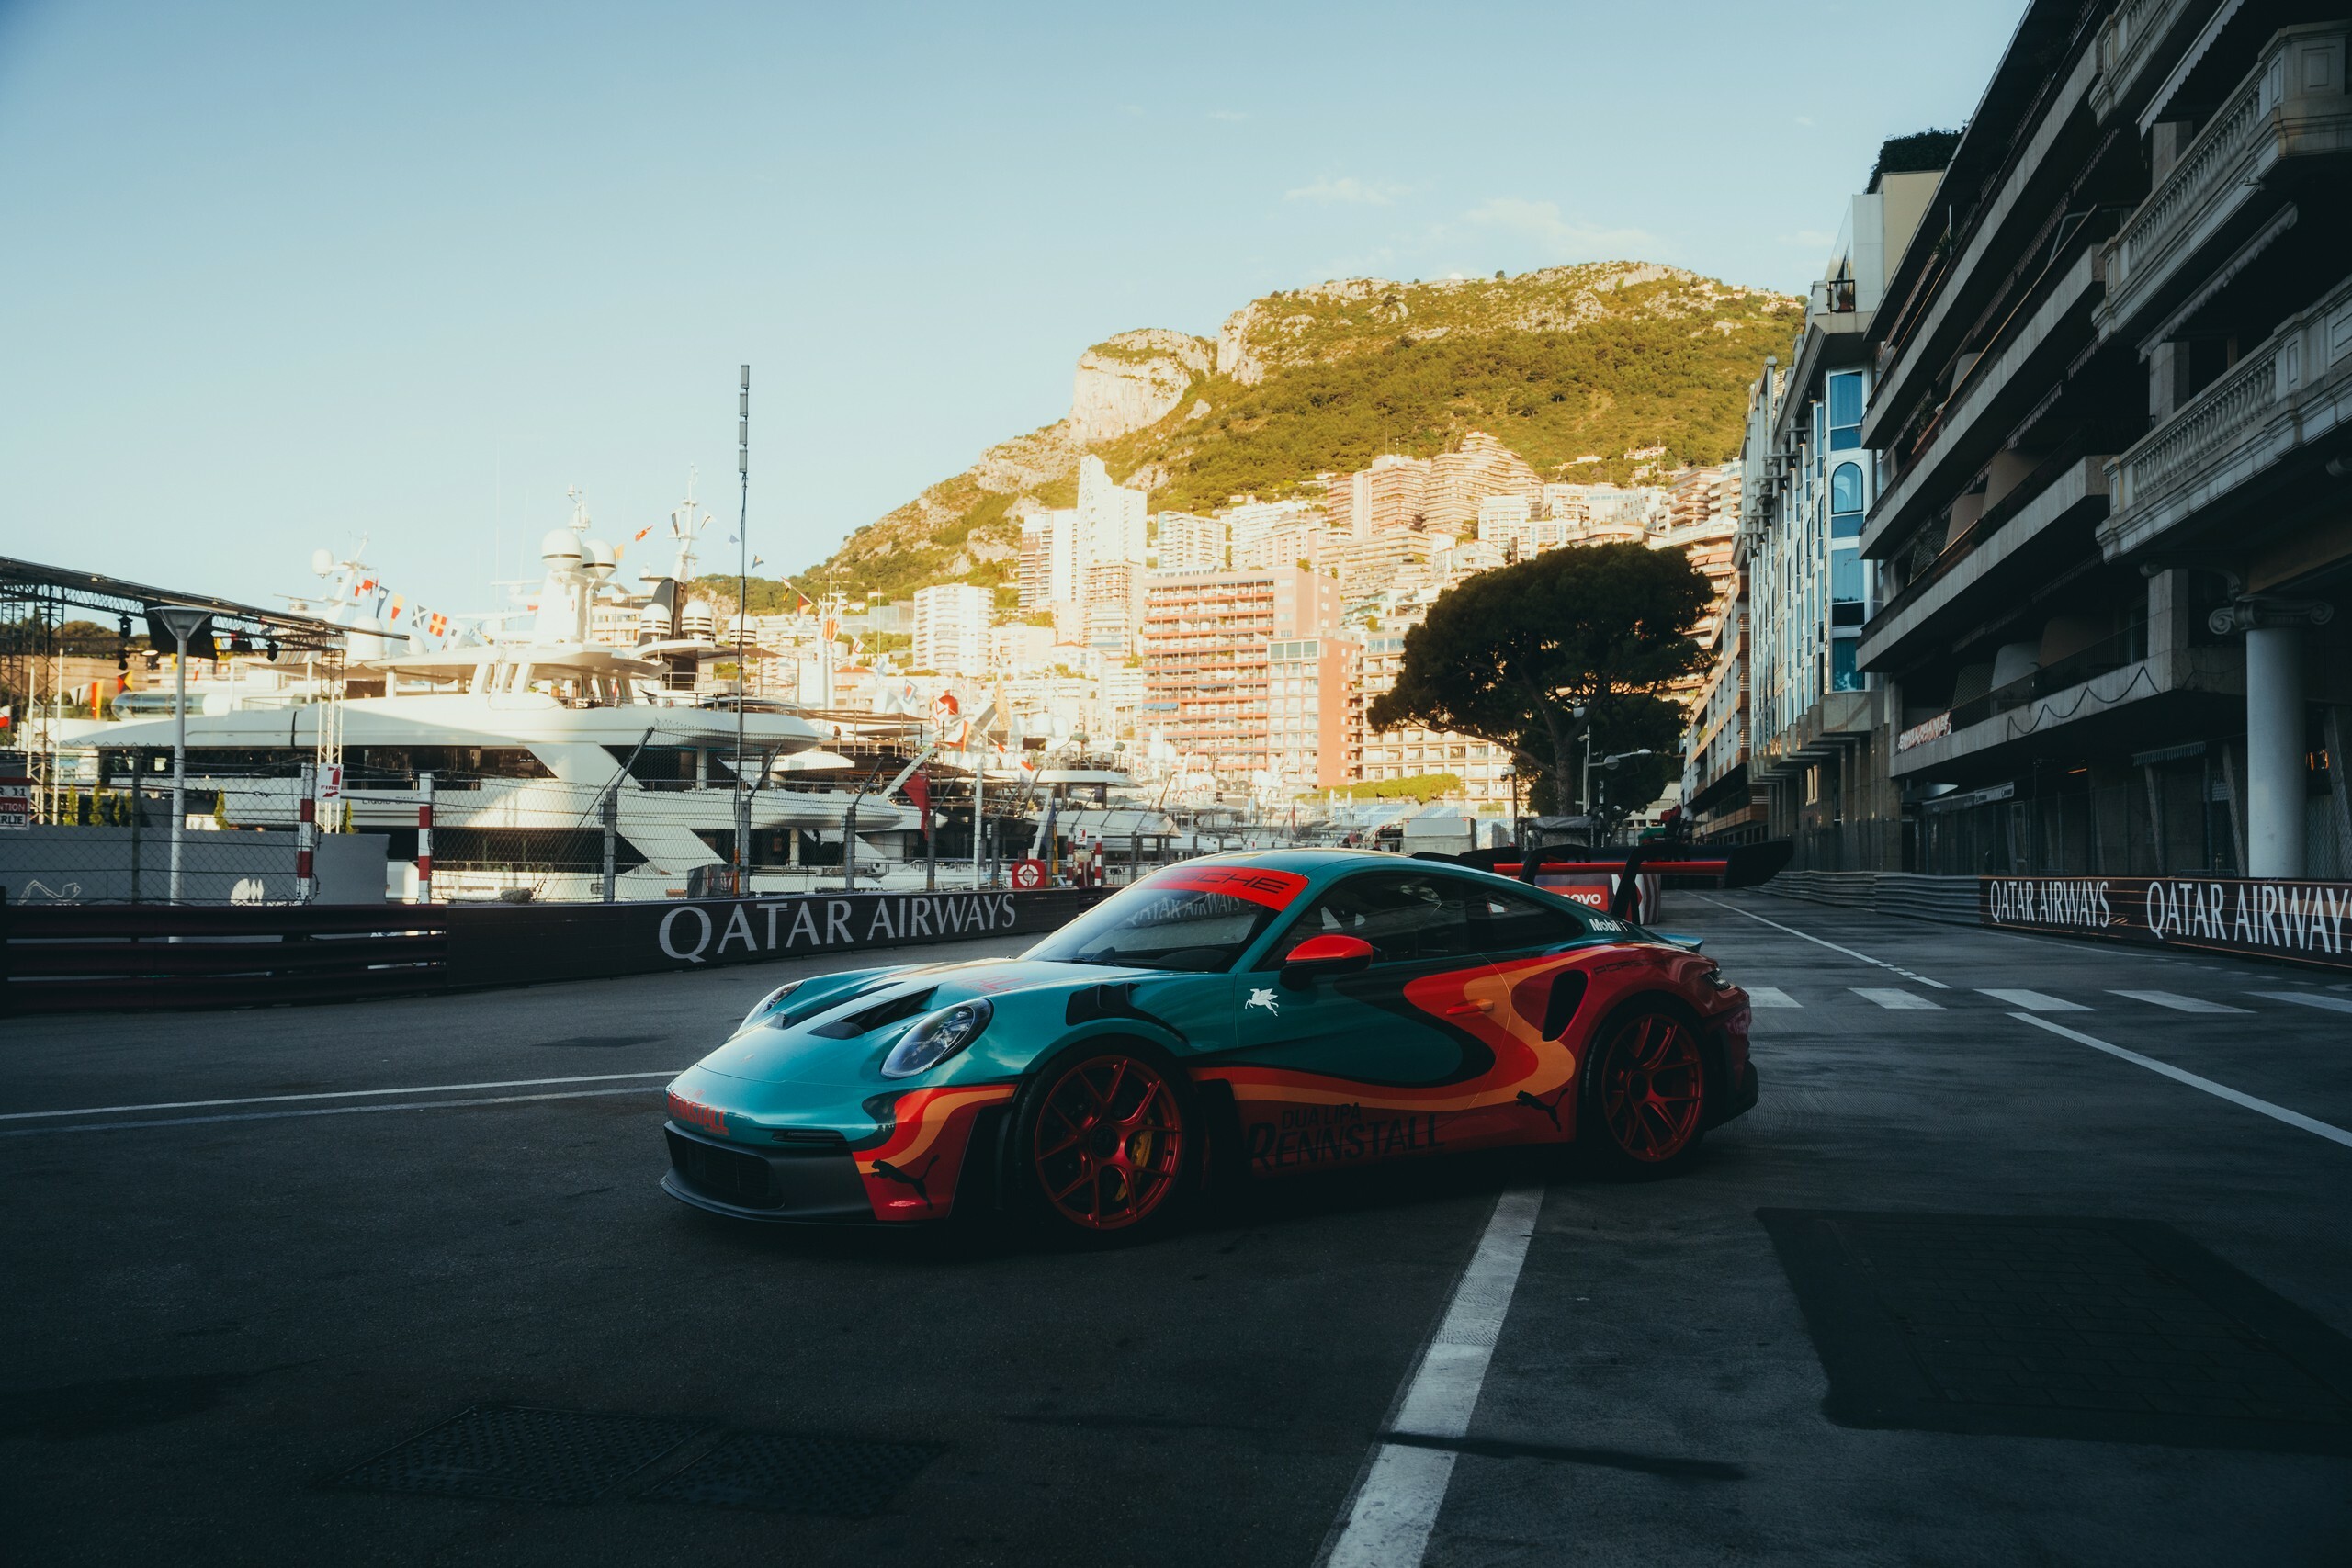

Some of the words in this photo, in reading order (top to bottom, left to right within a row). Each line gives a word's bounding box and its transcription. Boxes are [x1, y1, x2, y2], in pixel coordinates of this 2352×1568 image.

[659, 900, 854, 964] QATAR
[867, 894, 1016, 941] AIRWAYS
[1589, 919, 1622, 931] Mobil
[1990, 880, 2035, 923] QATAR
[2039, 880, 2109, 928] AIRWAYS
[2146, 881, 2227, 940] QATAR
[2234, 884, 2352, 954] AIRWAY
[1248, 1113, 1446, 1171] RENNSTALL
[1282, 1107, 1319, 1130] DUA
[1323, 1101, 1362, 1124] LIPA
